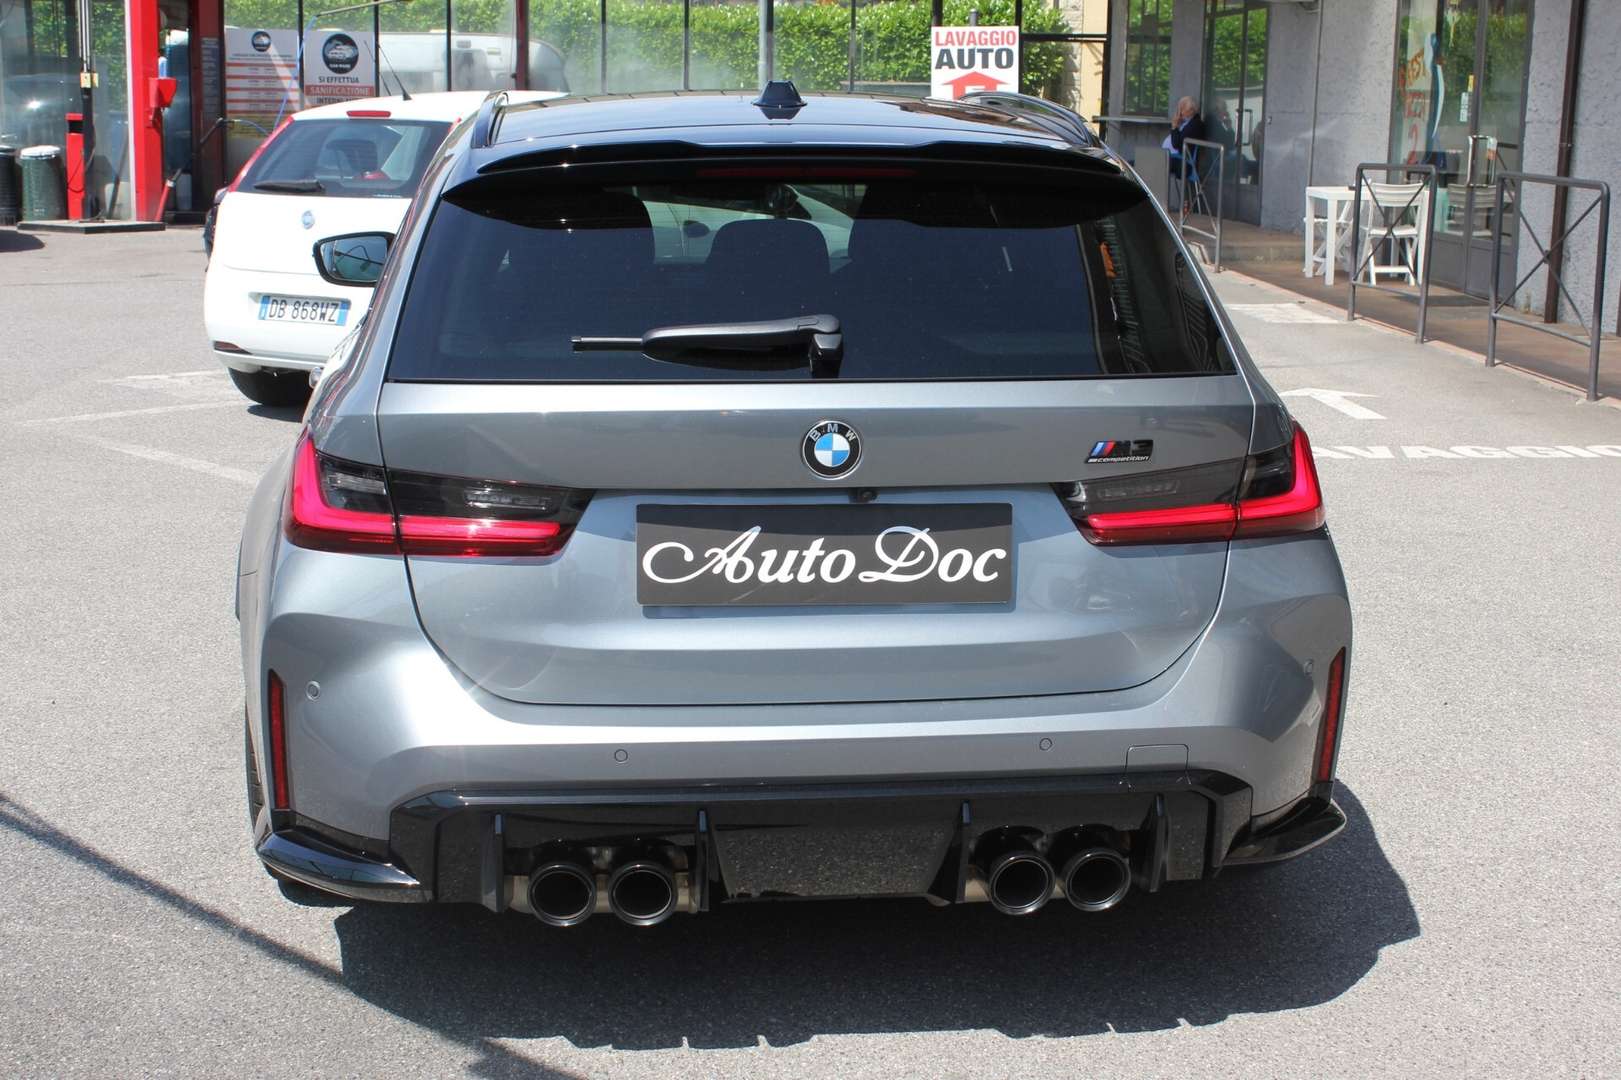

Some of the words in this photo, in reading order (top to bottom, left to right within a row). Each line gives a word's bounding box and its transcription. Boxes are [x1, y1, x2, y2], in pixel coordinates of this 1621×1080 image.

[935, 30, 1016, 46] LAVAGGIO
[935, 47, 1014, 69] AUTO
[310, 86, 369, 96] SANIFICAZIONE
[268, 299, 288, 318] DB
[291, 300, 338, 322] 868WZ
[809, 423, 857, 442] BMW
[1097, 455, 1149, 463] competition
[1311, 445, 1621, 458] AVAGGIO
[642, 525, 856, 584] Auto
[858, 525, 1006, 583] Doc
